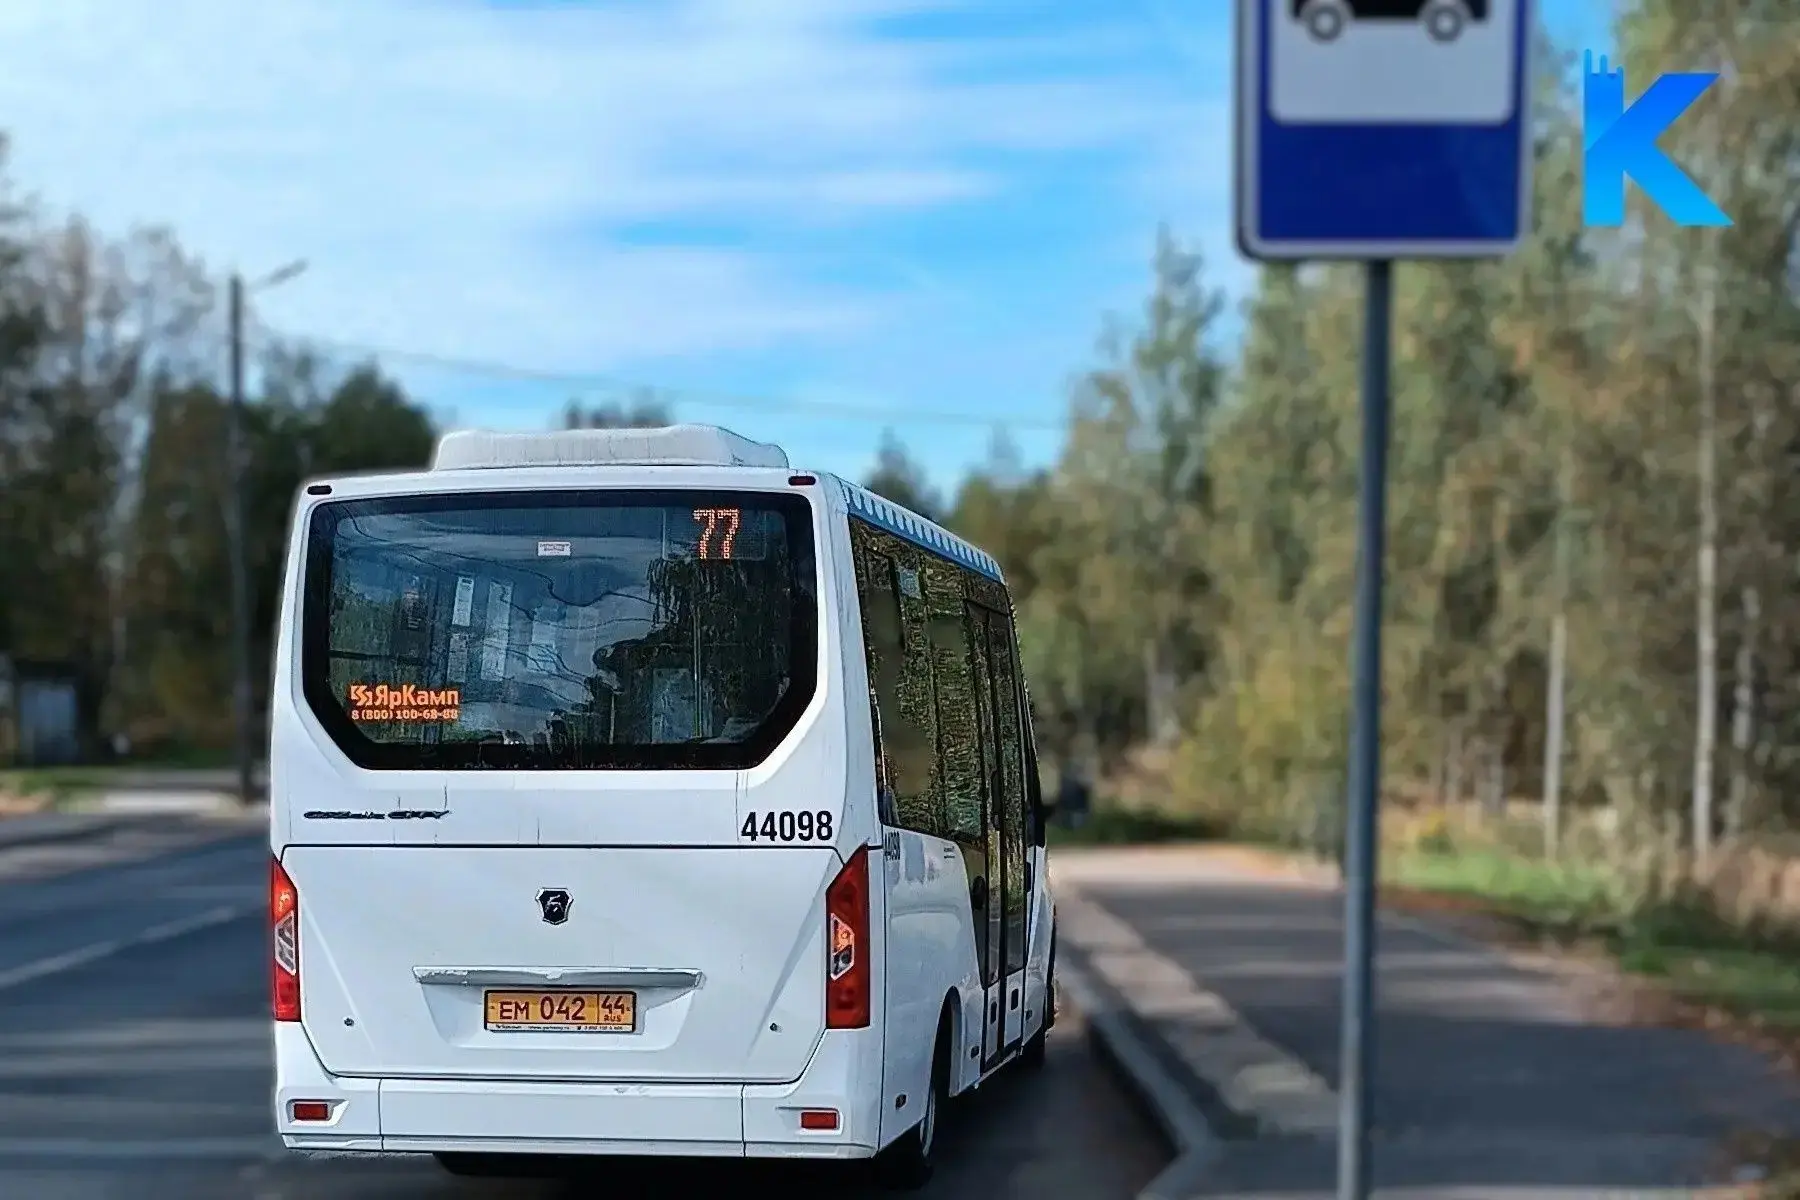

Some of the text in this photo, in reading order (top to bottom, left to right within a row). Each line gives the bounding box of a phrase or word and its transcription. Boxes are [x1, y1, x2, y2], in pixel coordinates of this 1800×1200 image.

[693, 509, 739, 559] 77
[374, 684, 459, 709] ЯрКамп
[351, 709, 360, 720] 8
[741, 810, 833, 842] 44098
[499, 995, 625, 1020] ЕМ 042 44
[603, 1014, 622, 1022] RUS
